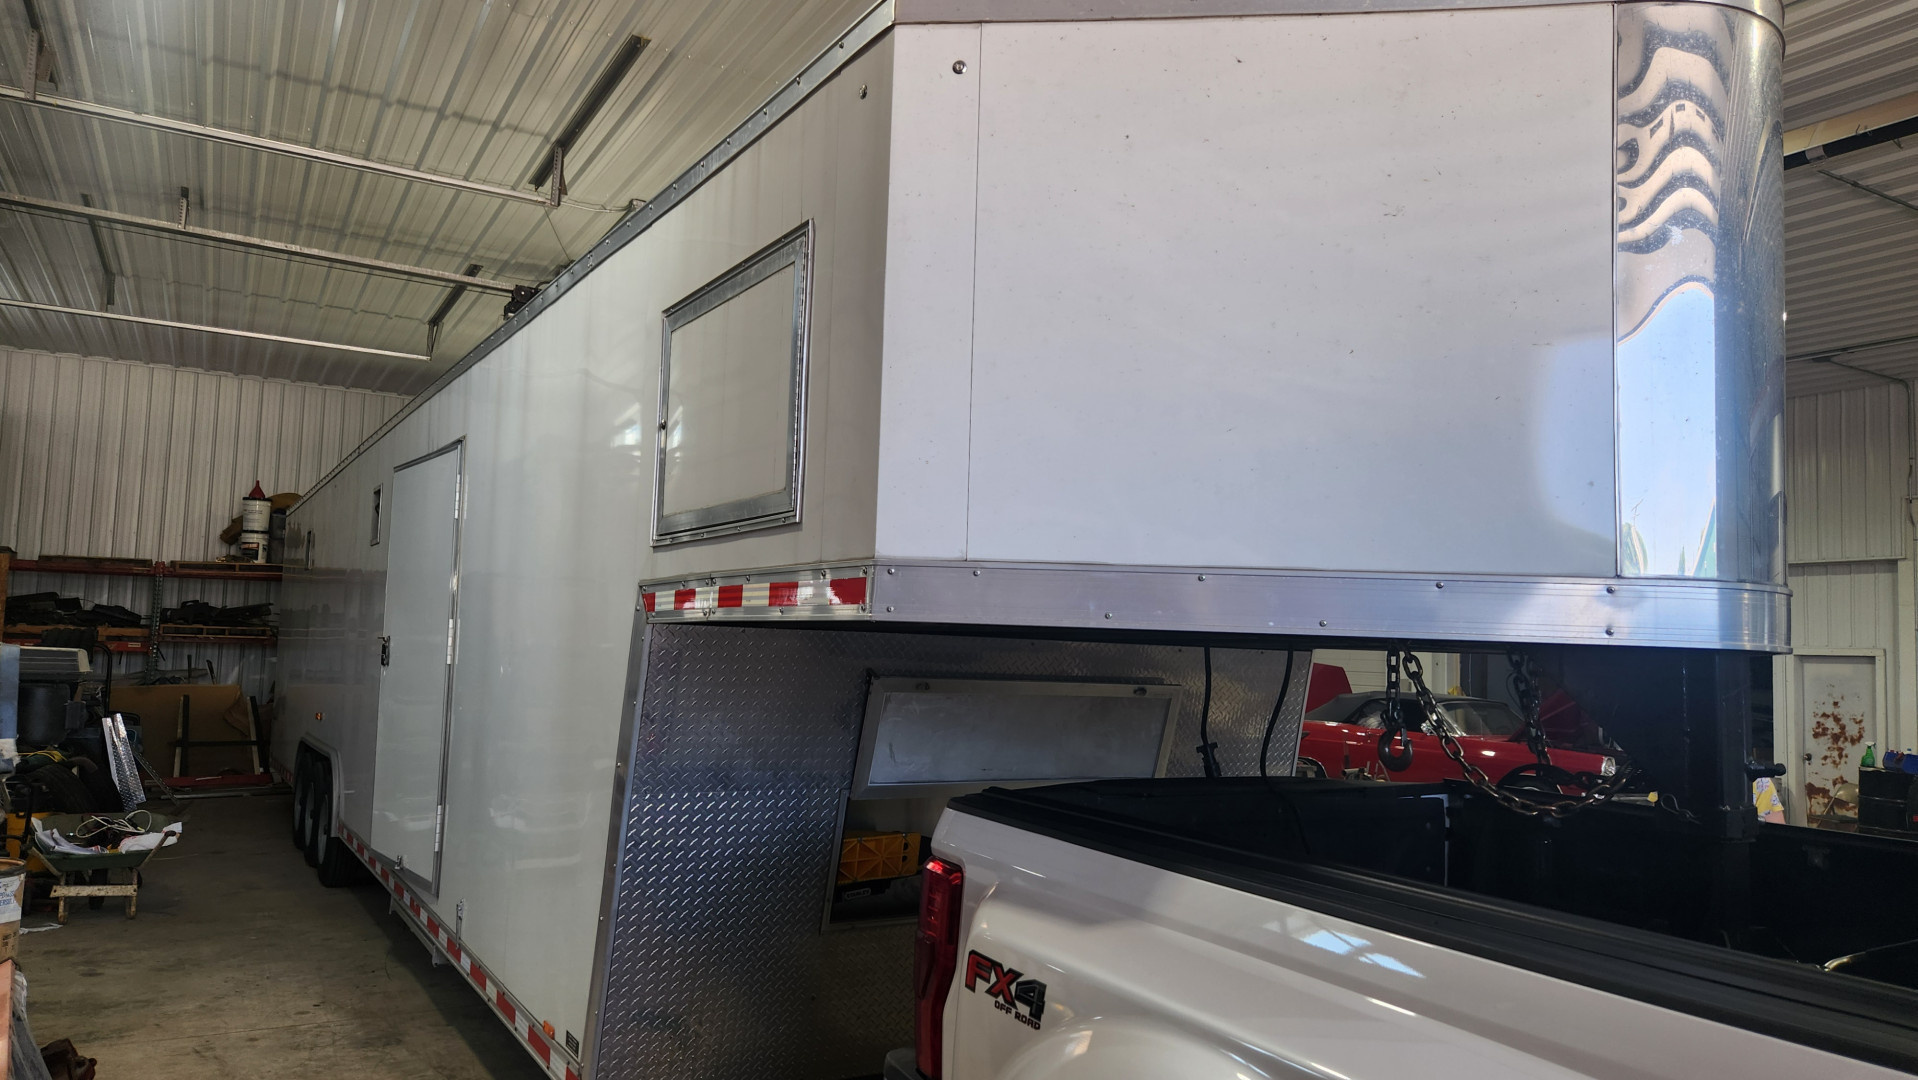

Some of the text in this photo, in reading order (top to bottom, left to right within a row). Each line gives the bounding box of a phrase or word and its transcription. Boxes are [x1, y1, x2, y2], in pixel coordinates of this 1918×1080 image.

[965, 949, 1047, 1022] FX4
[994, 1000, 1041, 1030] OFF ROAD
